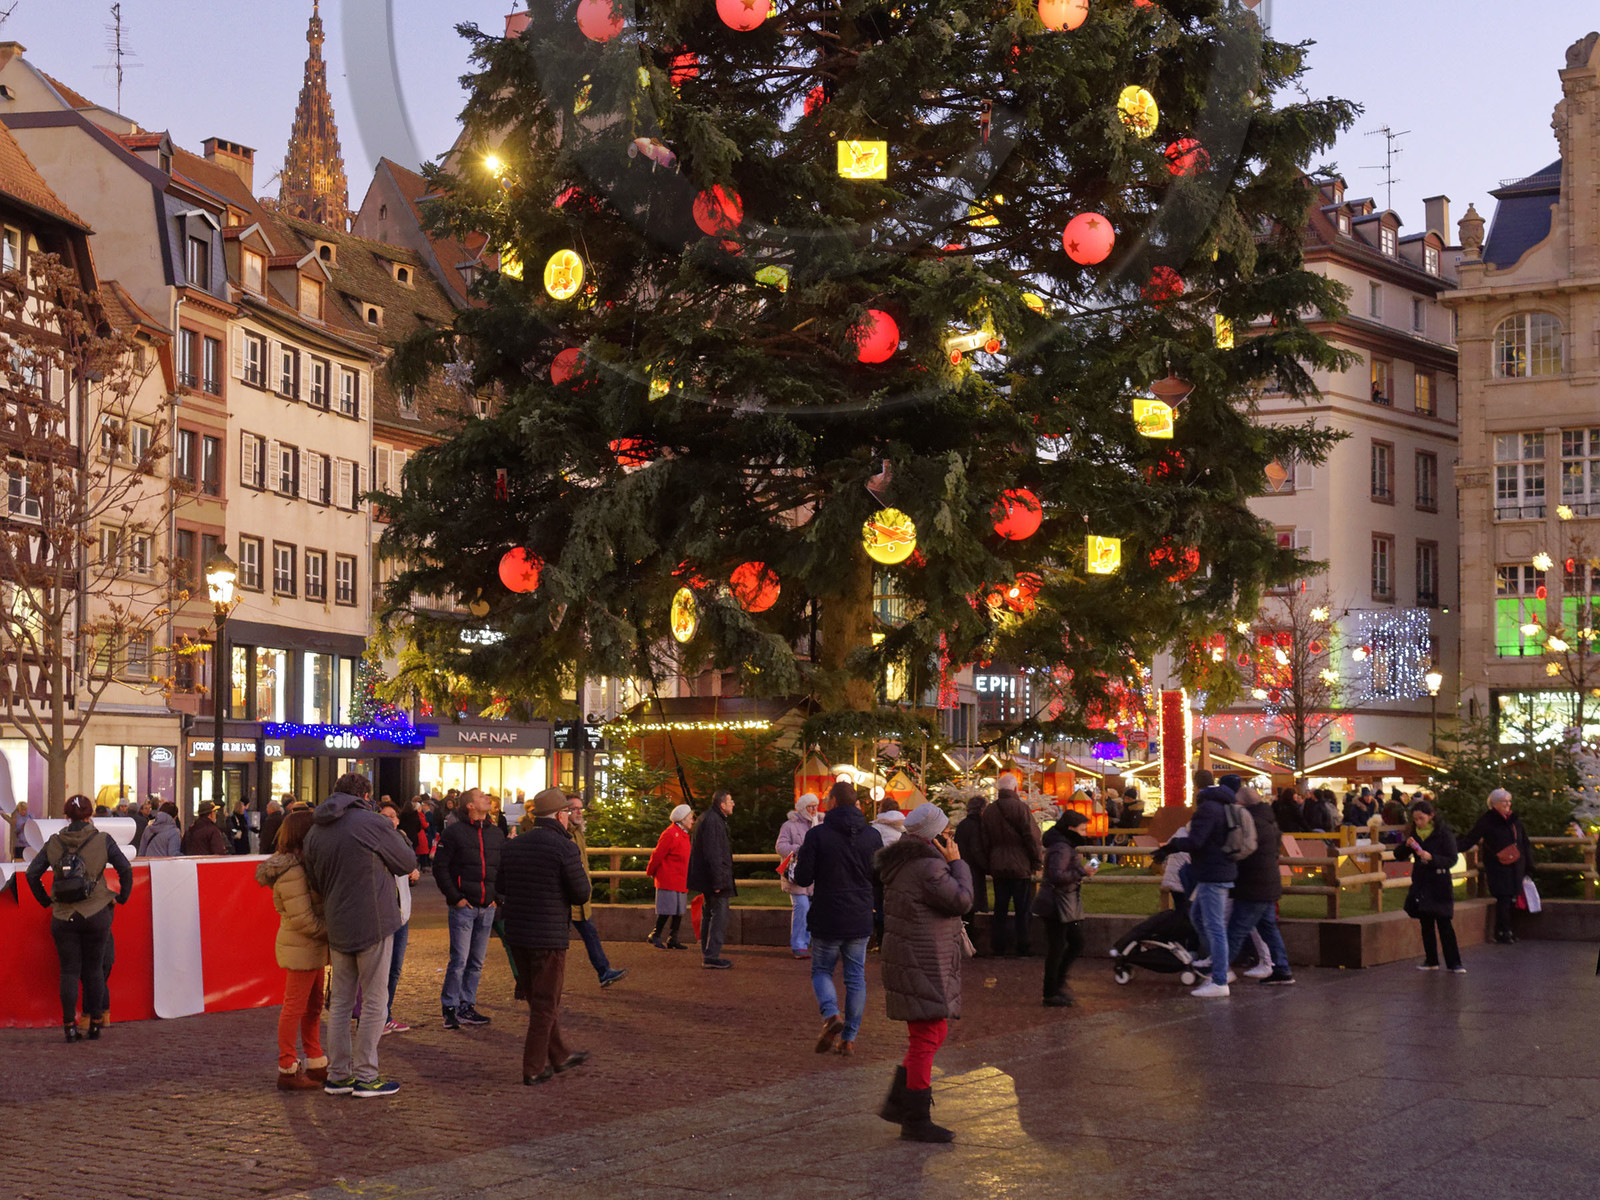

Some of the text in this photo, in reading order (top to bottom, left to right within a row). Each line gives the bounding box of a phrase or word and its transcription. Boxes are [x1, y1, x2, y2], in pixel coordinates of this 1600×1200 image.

[458, 731, 518, 743] NAF NAF
[195, 742, 229, 751] COMPIR
[264, 745, 281, 756] OR
